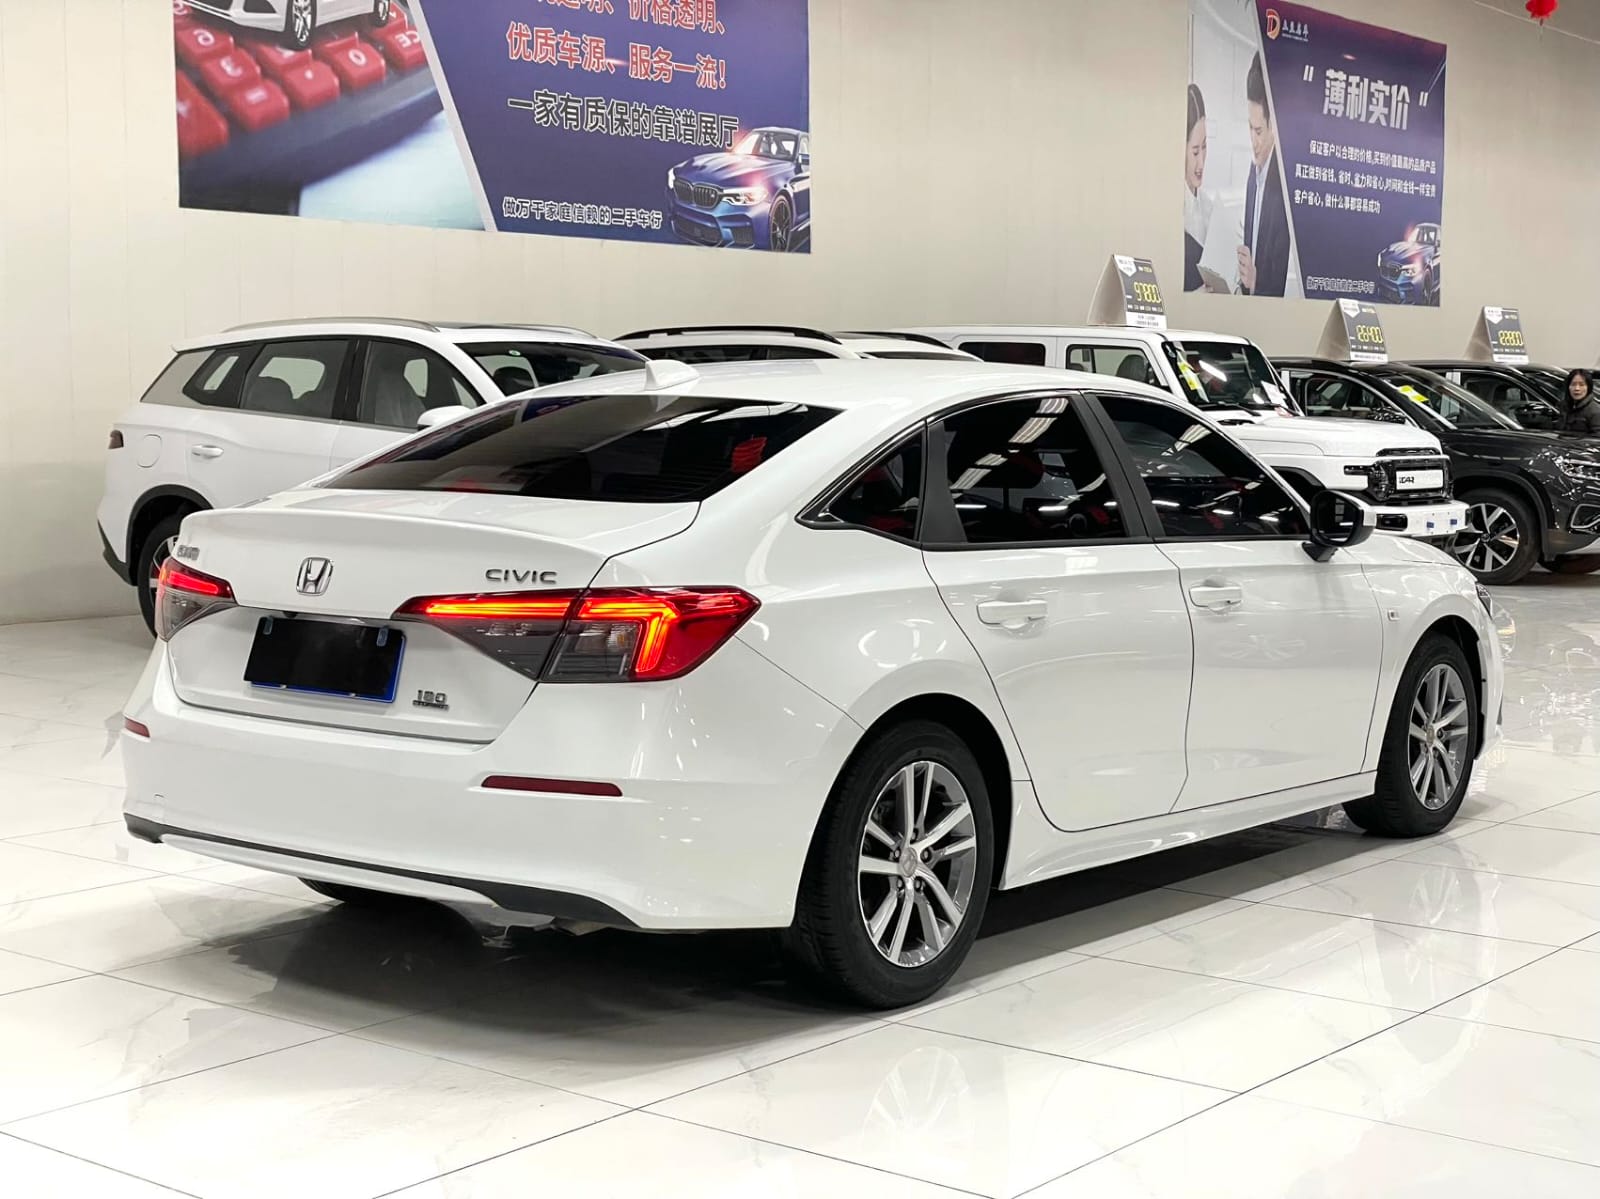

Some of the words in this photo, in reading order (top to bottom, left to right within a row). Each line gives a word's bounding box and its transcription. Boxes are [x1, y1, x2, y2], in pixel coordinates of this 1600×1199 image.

[507, 89, 739, 149] 一家有质保的靠谱展厅
[502, 196, 664, 230] 做万千家庭信赖的二手车行
[485, 568, 557, 585] CIVIC
